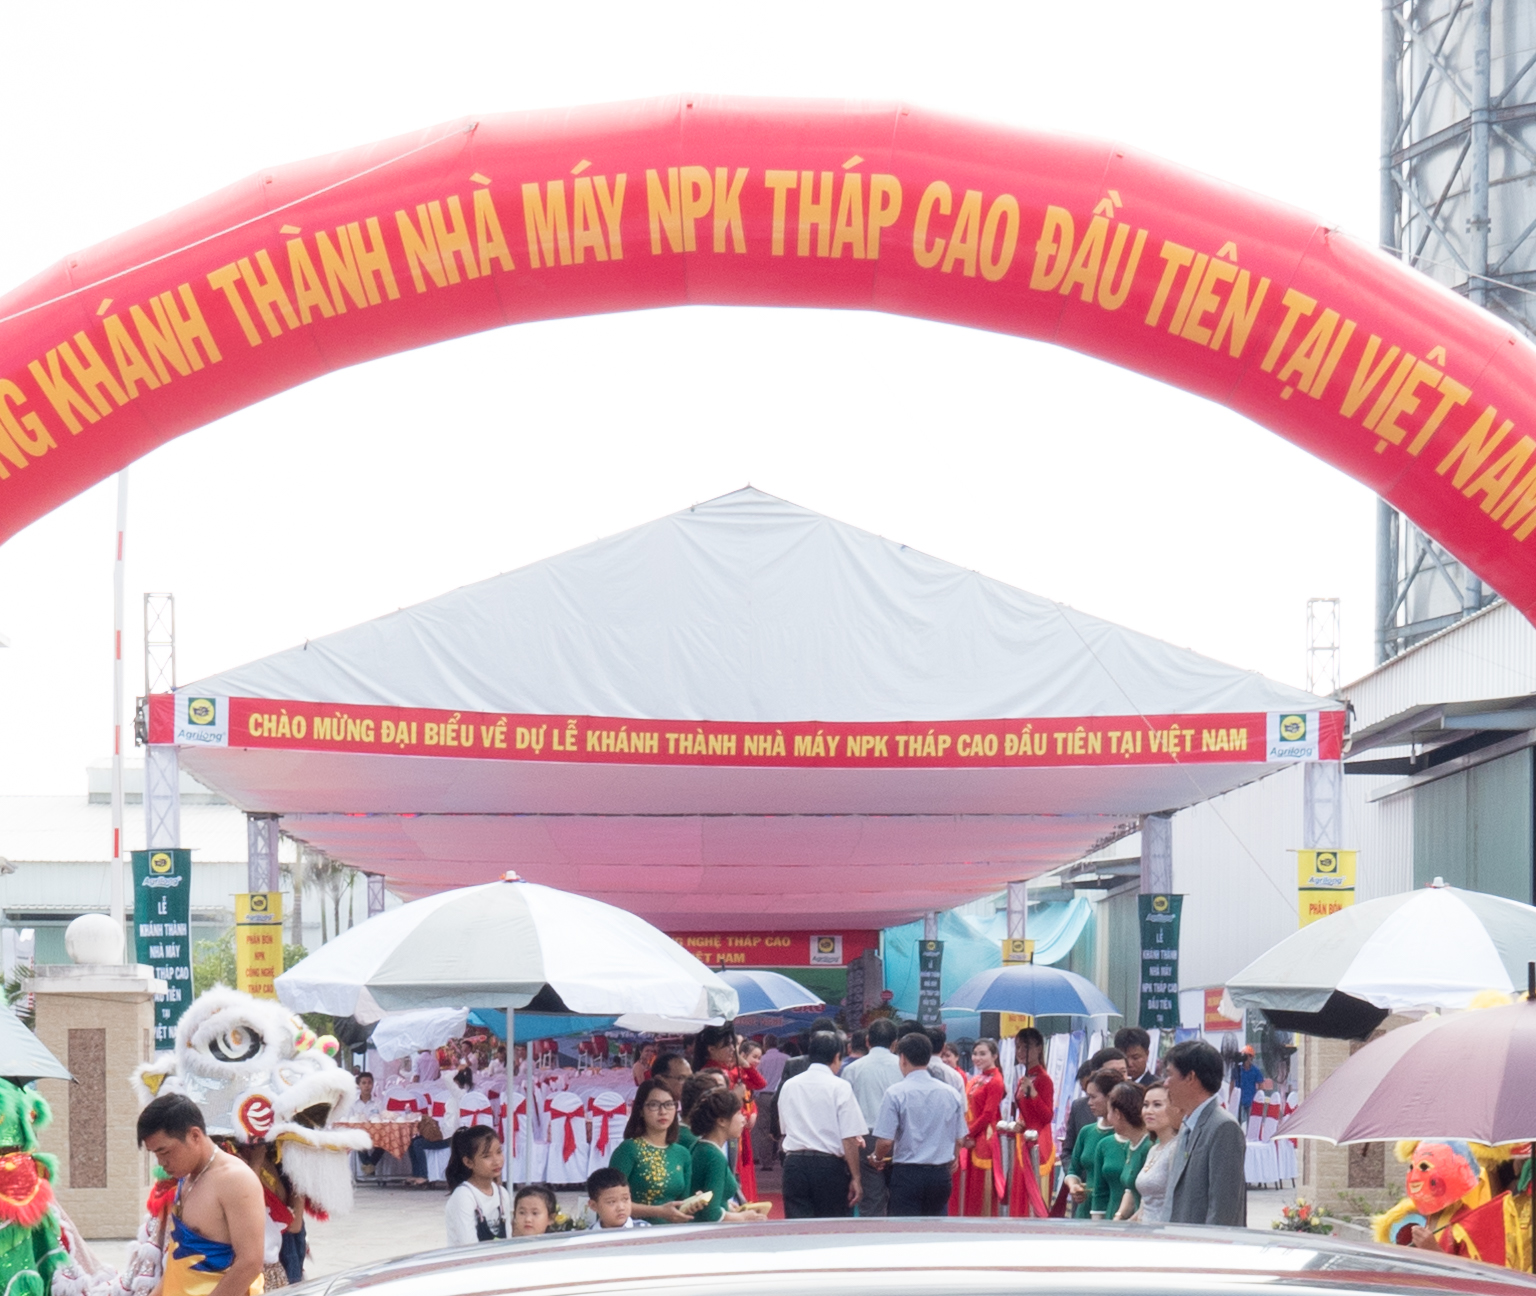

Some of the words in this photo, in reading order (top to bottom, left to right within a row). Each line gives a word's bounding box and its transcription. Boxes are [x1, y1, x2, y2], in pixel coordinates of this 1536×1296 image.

[33, 298, 222, 435] KHÁNH
[208, 224, 400, 347] THÀNH
[395, 173, 516, 293] NHÀ
[521, 159, 627, 269] MÁY
[645, 166, 749, 254] NPK
[764, 155, 902, 260] THÁP
[912, 180, 1020, 281] CAO
[1030, 190, 1146, 311] ĐẦU
[1144, 242, 1271, 358] TIÊN
[1259, 288, 1357, 400] TẠI
[1339, 347, 1473, 455] VIỆT
[177, 729, 223, 743] Agrilong
[248, 709, 307, 739] CHÀO
[313, 712, 375, 742] MỪNG
[381, 721, 417, 749] ĐẠI
[424, 712, 474, 747] BIỂU
[481, 717, 508, 748] VỀ
[516, 724, 547, 754] DỰ
[552, 719, 578, 751] LỄ
[586, 726, 659, 754] KHÁNH
[665, 728, 737, 756] THÀNH
[743, 730, 786, 756] NHÀ
[794, 730, 840, 757] MÁY
[846, 735, 889, 757] NPK
[895, 729, 952, 757] THÁP
[957, 733, 998, 756] CAO
[1004, 724, 1047, 756] ĐẦU
[1053, 726, 1102, 755] TIÊN
[1108, 730, 1142, 758] TẠI
[1148, 724, 1195, 757] VIỆT
[1201, 728, 1247, 752] NAM
[1269, 746, 1313, 758] Agrilong
